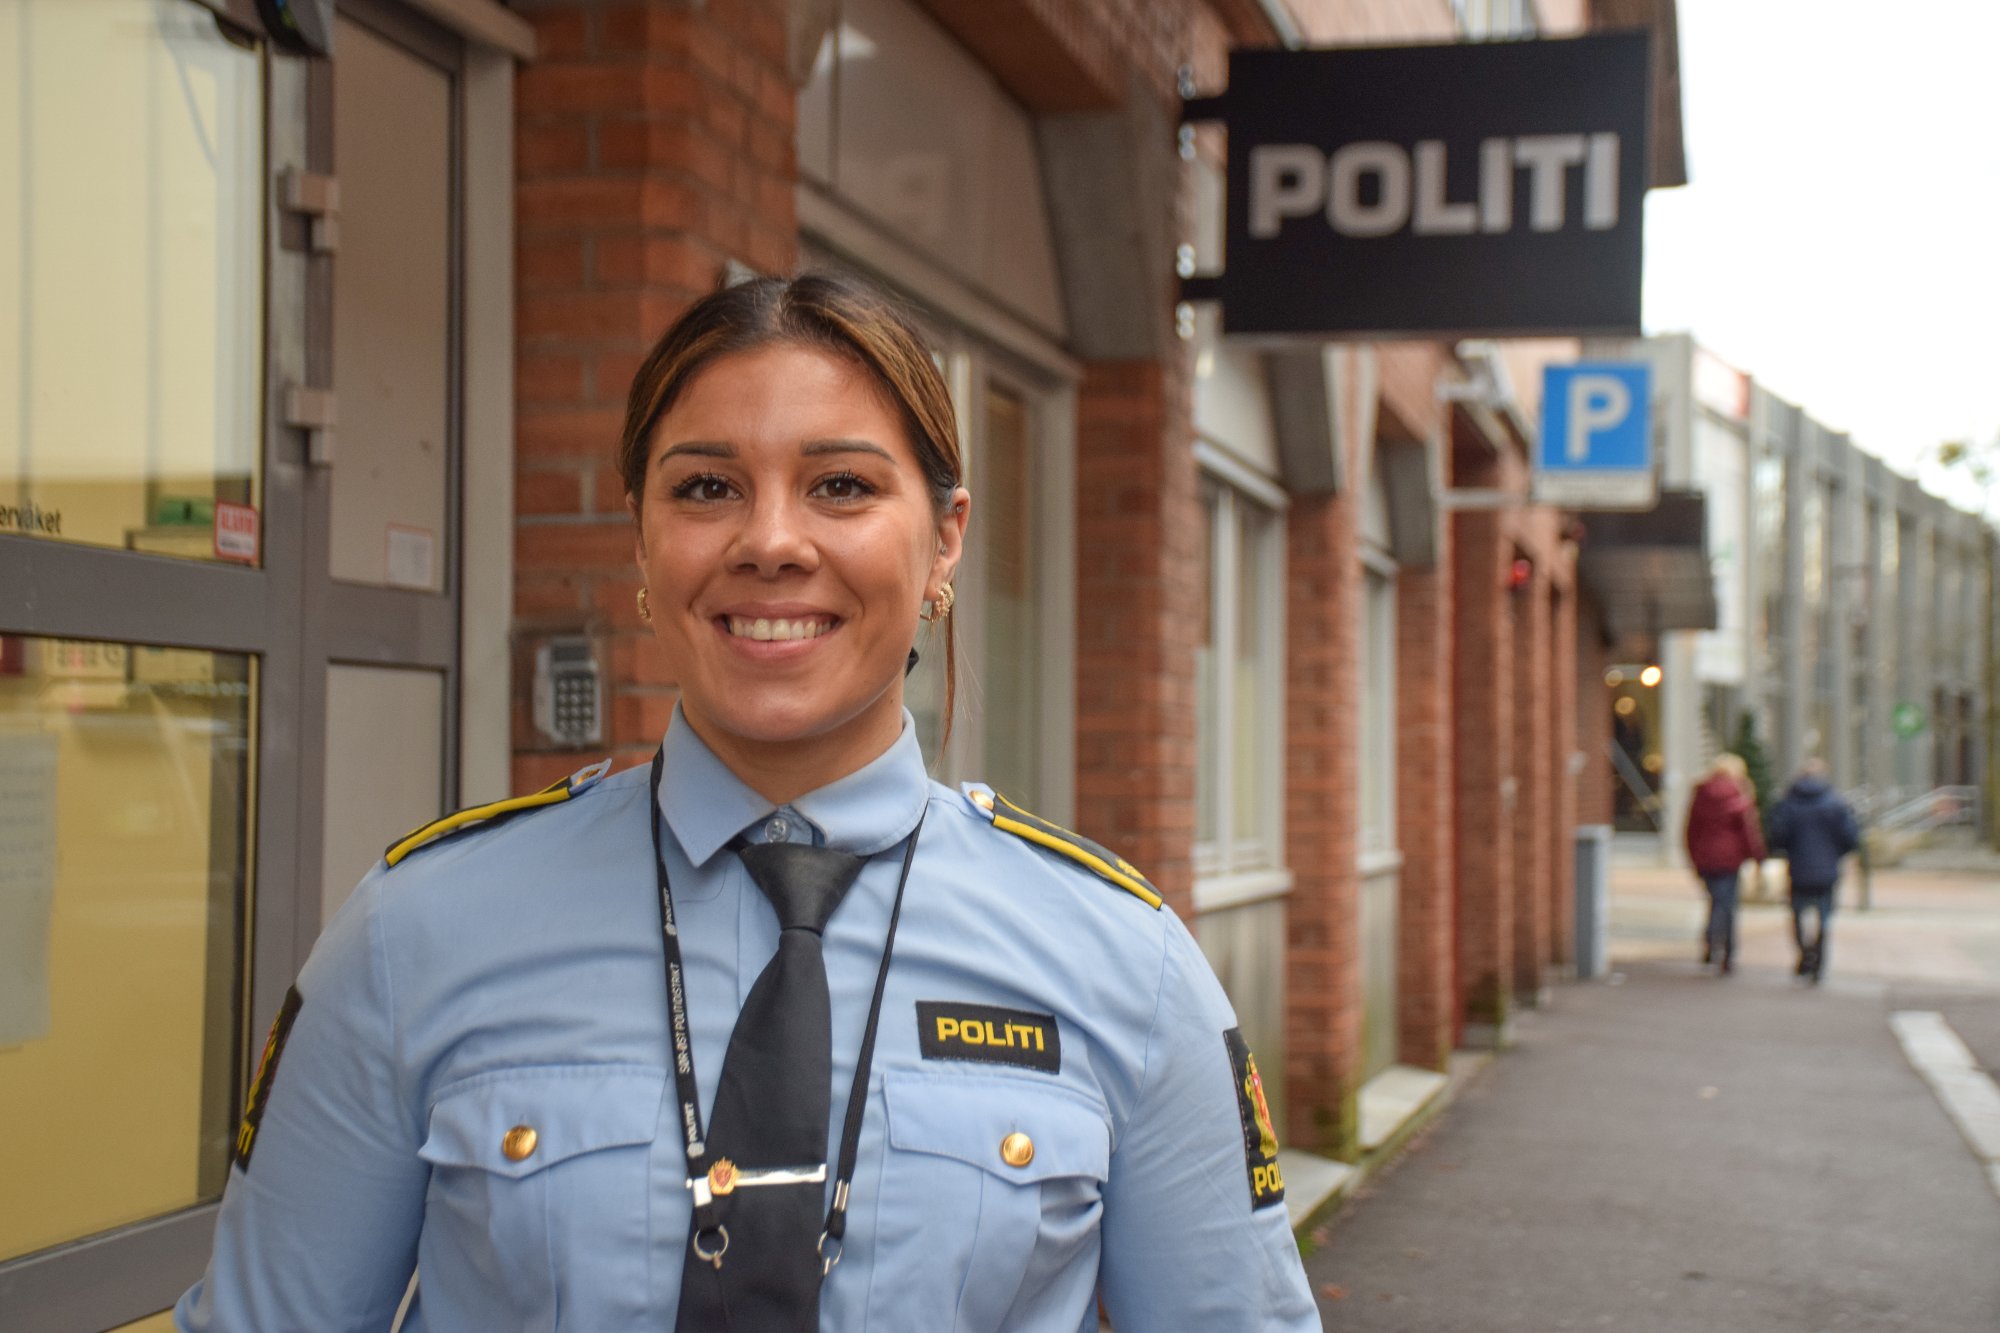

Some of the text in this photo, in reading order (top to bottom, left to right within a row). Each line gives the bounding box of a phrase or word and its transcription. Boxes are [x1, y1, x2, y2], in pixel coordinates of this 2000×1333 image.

[1248, 132, 1620, 238] POLITI
[1567, 374, 1631, 461] P
[670, 962, 690, 1074] SØR-ØST POLITIDISTRIKT
[936, 1017, 1045, 1051] POLITI
